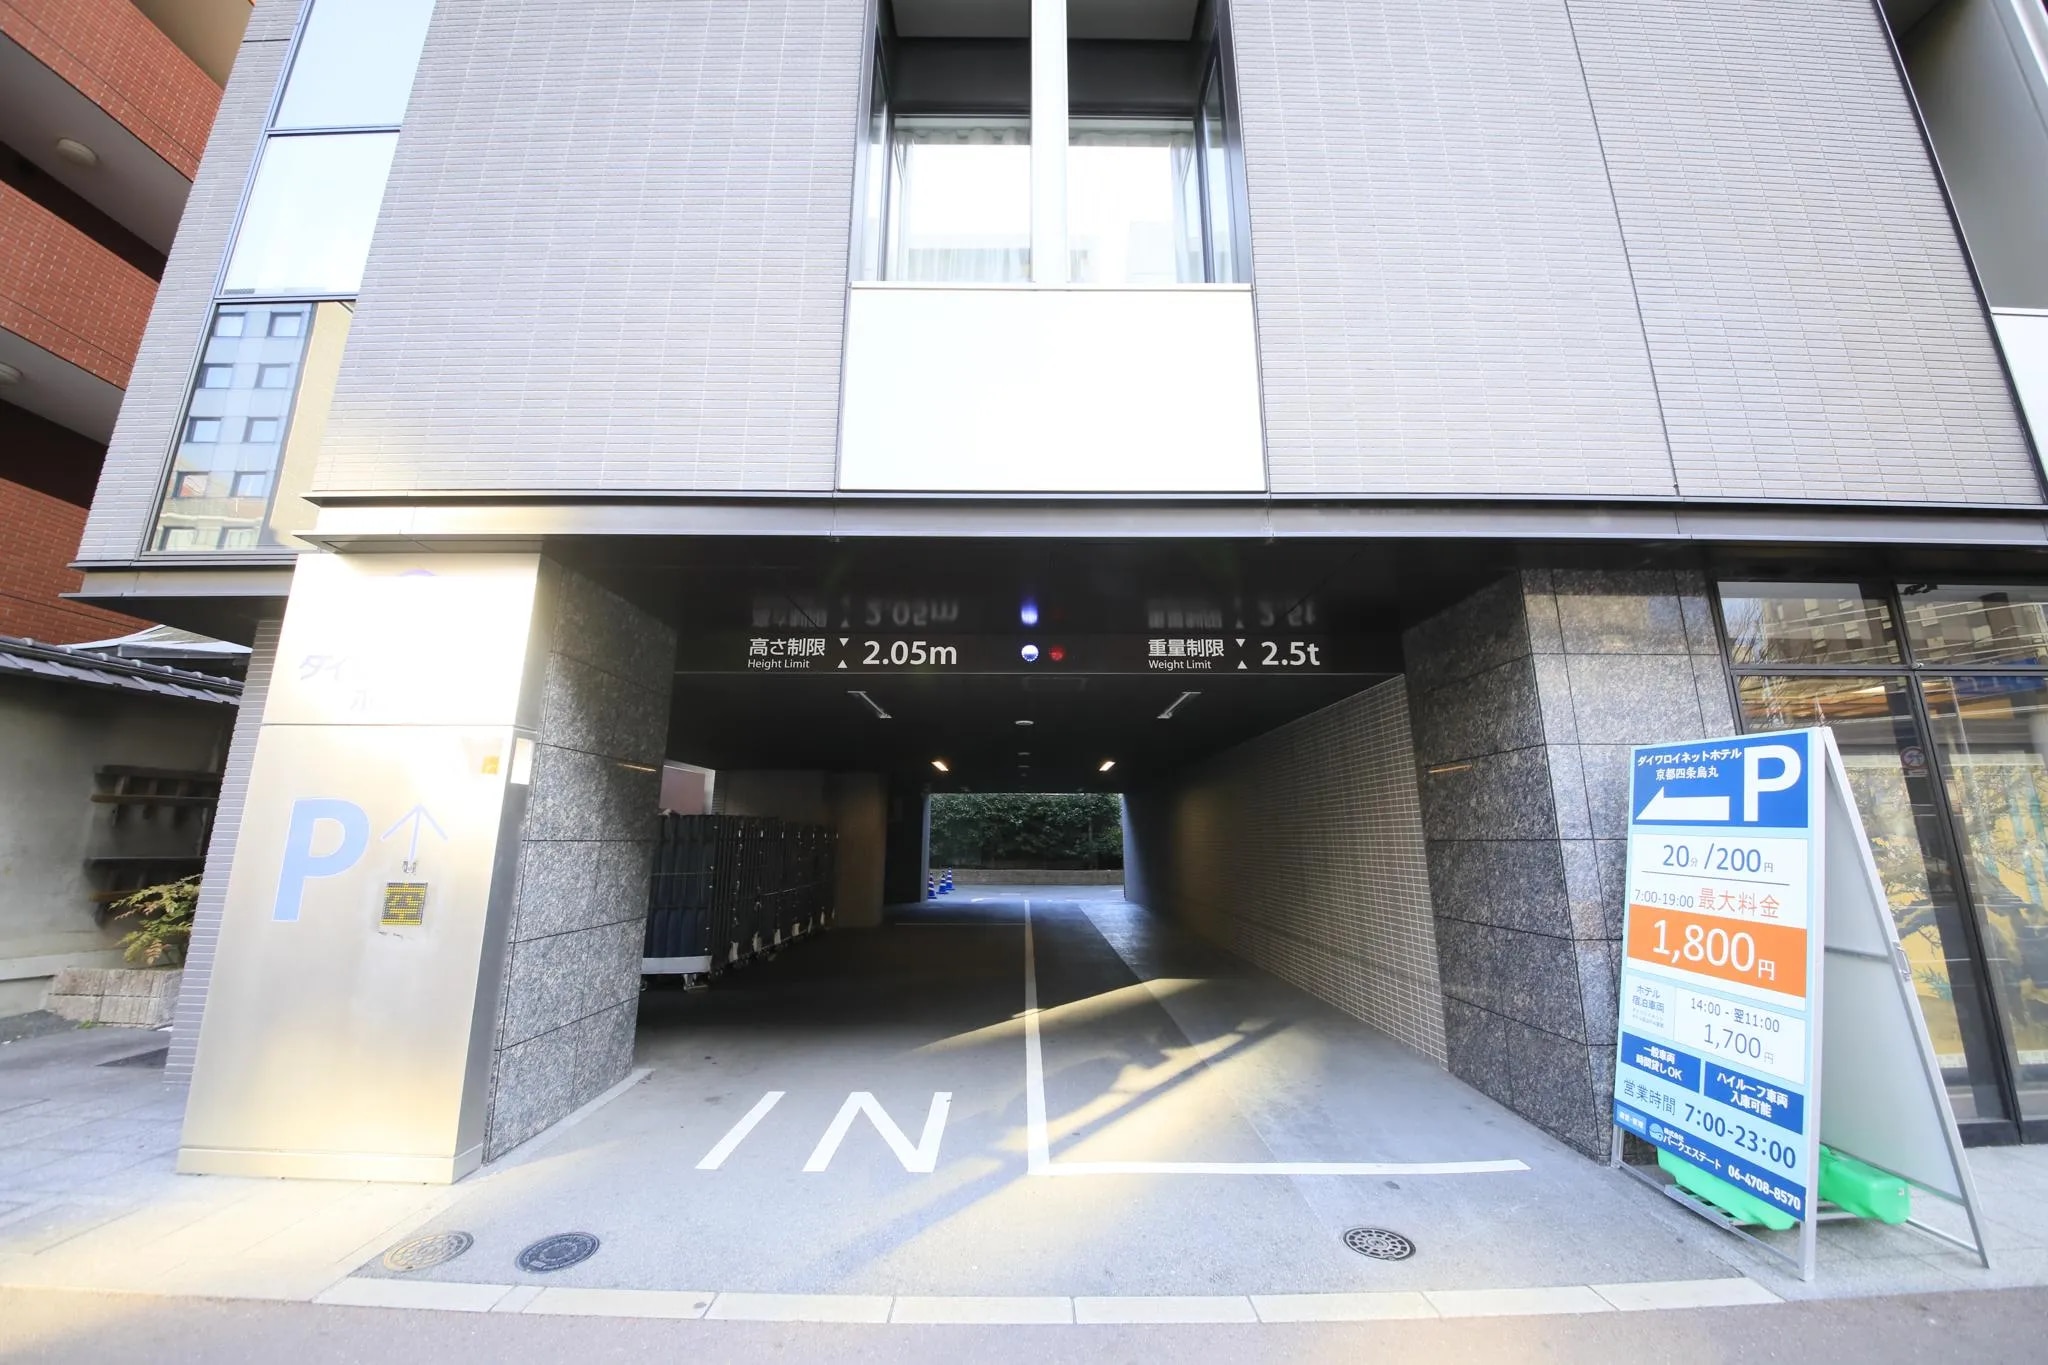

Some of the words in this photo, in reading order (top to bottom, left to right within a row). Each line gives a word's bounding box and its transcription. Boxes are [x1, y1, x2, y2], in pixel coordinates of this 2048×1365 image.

[749, 638, 826, 657] 高さ制限
[862, 641, 957, 665] 2.05m
[1148, 639, 1225, 657] 重量制限
[1261, 641, 1321, 666] 2.5t
[748, 659, 782, 671] Height
[784, 659, 810, 669] Limit
[1149, 660, 1184, 671] Weight
[1187, 660, 1212, 669] Limit
[1638, 748, 1742, 766] ダイワロイネットホテル
[1656, 765, 1719, 781] 京都四条烏丸
[1744, 745, 1801, 822] P
[272, 797, 371, 922] P
[1635, 889, 1694, 908] 7:00-19:00
[1698, 888, 1780, 919] 最大料金
[1637, 985, 1661, 999] ホテル
[1716, 1071, 1789, 1109] ハイルーフ車両
[1730, 1092, 1773, 1118] 入庫可能
[695, 1090, 953, 1173] IN
[1623, 1079, 1676, 1117] 営業時間
[1684, 1103, 1796, 1169] 7:00-23:00
[1728, 1164, 1801, 1212] 06-4708-8570
